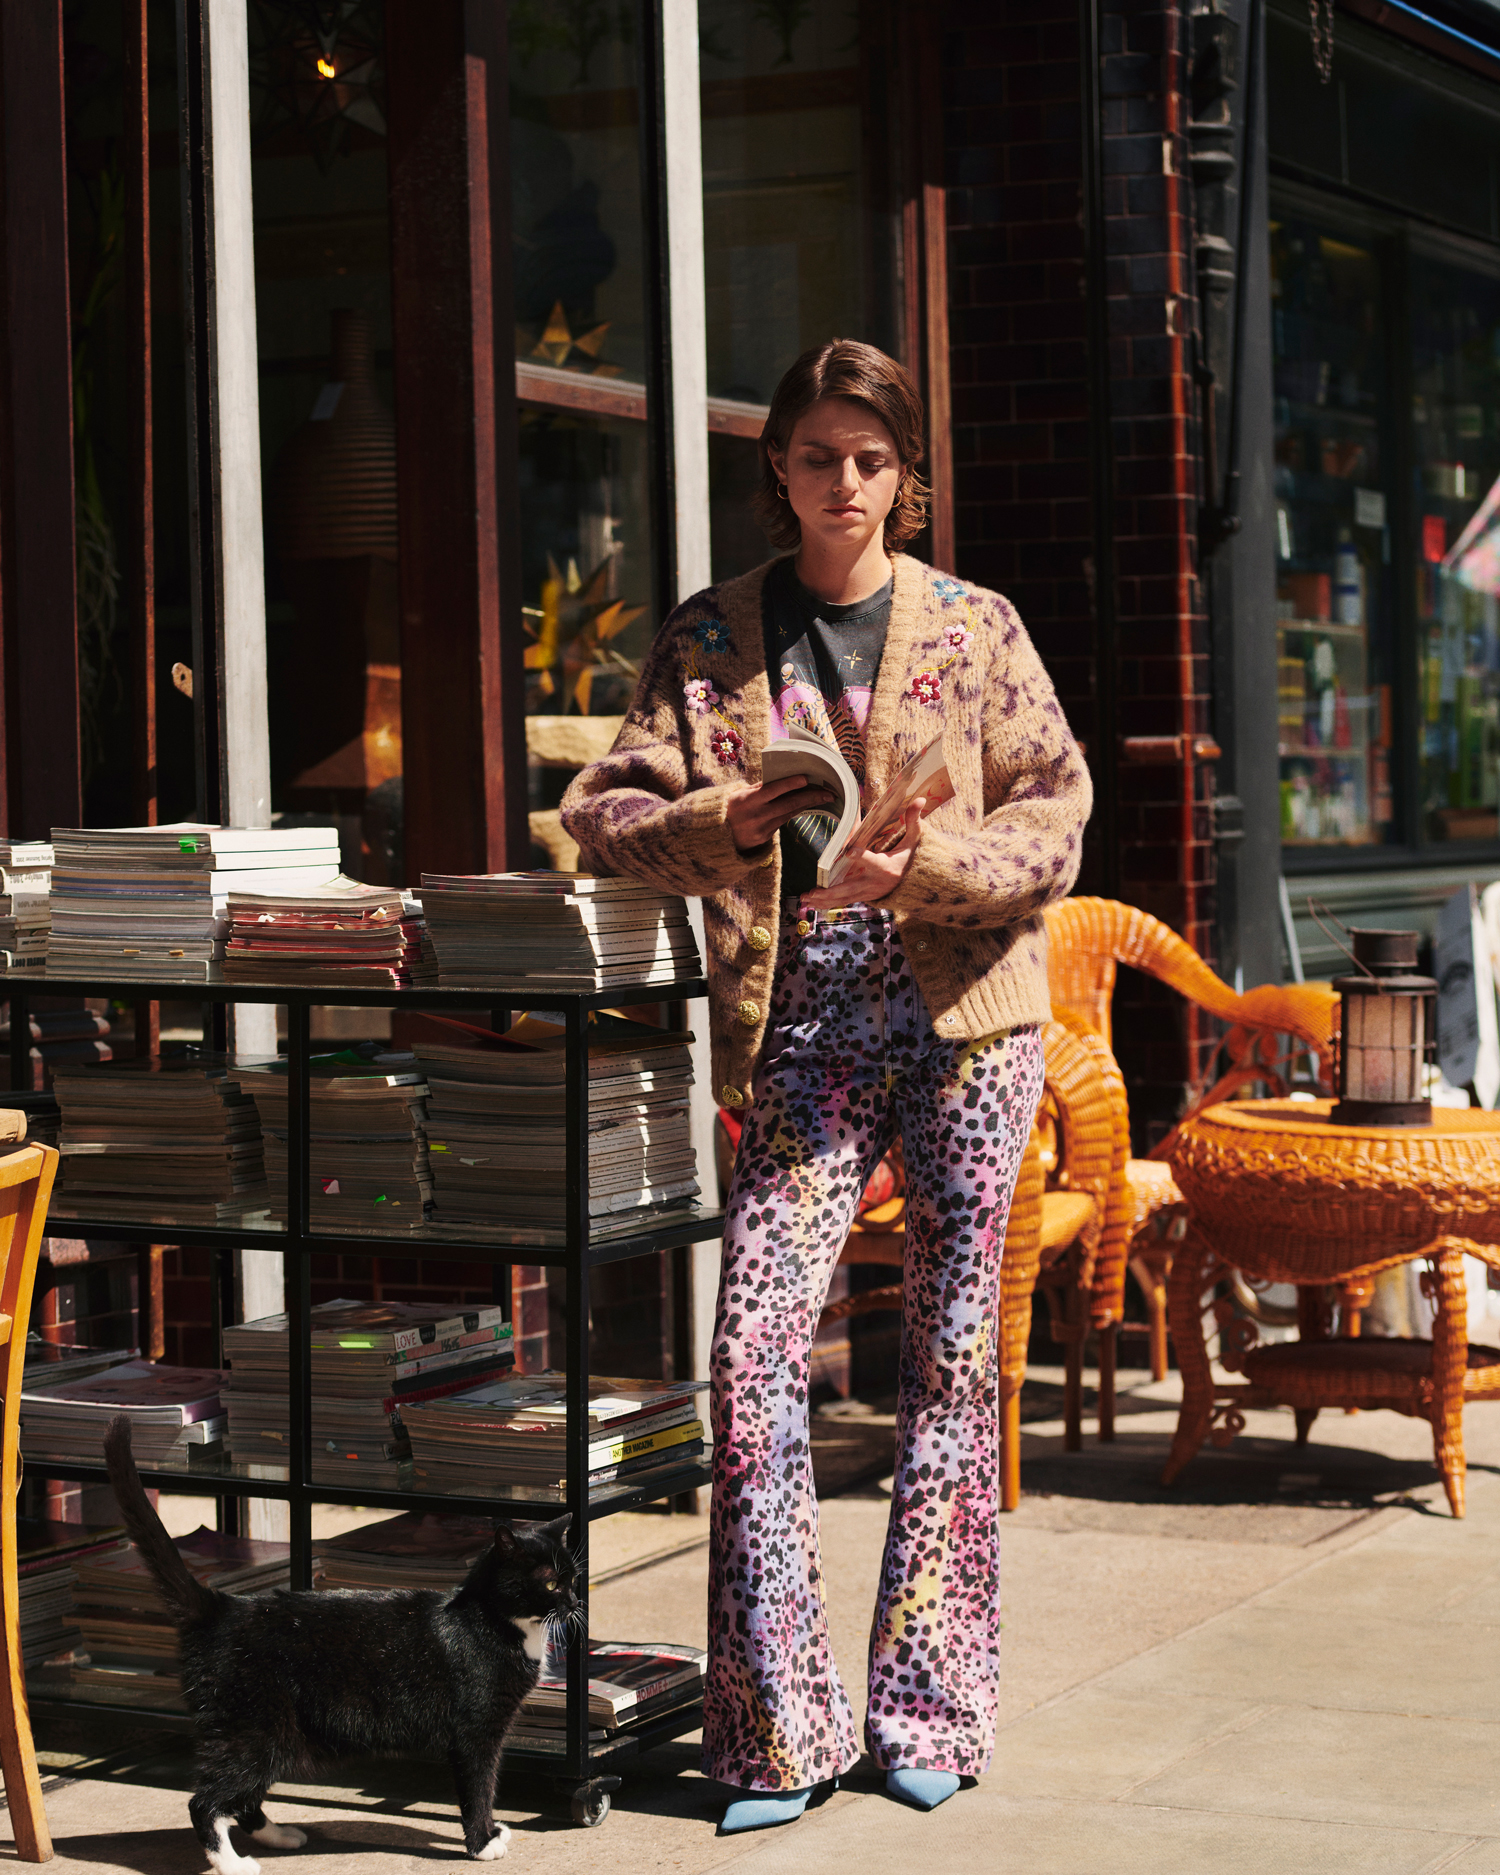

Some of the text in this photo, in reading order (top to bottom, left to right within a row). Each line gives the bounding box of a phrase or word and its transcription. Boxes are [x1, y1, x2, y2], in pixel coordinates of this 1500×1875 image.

[396, 1332, 417, 1350] LOVE
[390, 1413, 403, 1425] PO
[612, 1438, 654, 1458] ANOTHER MAGAZINE
